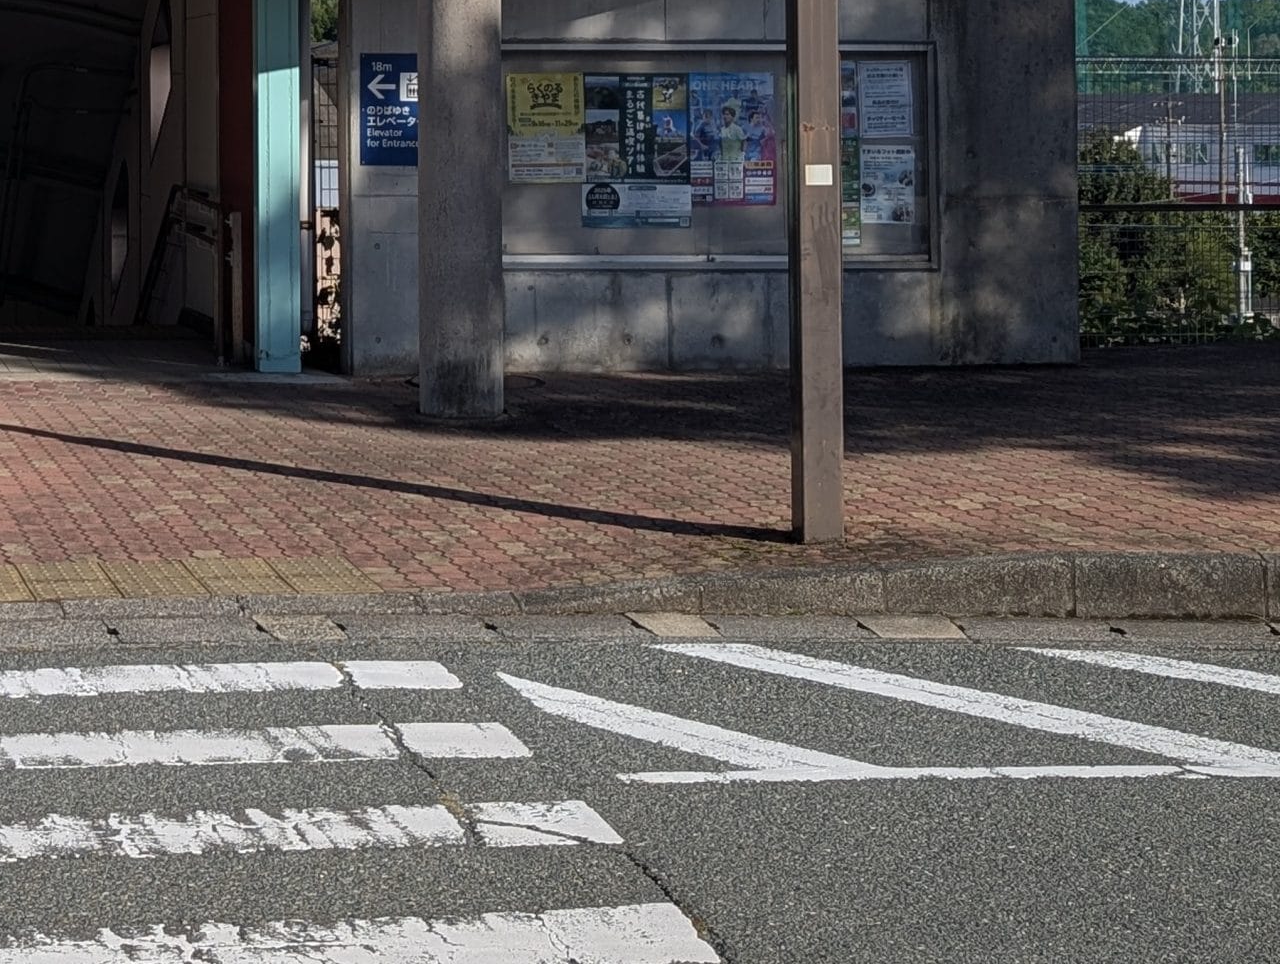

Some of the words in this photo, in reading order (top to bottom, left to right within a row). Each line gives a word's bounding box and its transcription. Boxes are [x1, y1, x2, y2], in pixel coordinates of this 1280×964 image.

[371, 61, 393, 72] 18m
[721, 80, 760, 91] HEART
[367, 106, 411, 116] のりばゆき
[367, 116, 419, 127] エレベータ
[367, 128, 403, 137] Elevator
[367, 138, 380, 148] for
